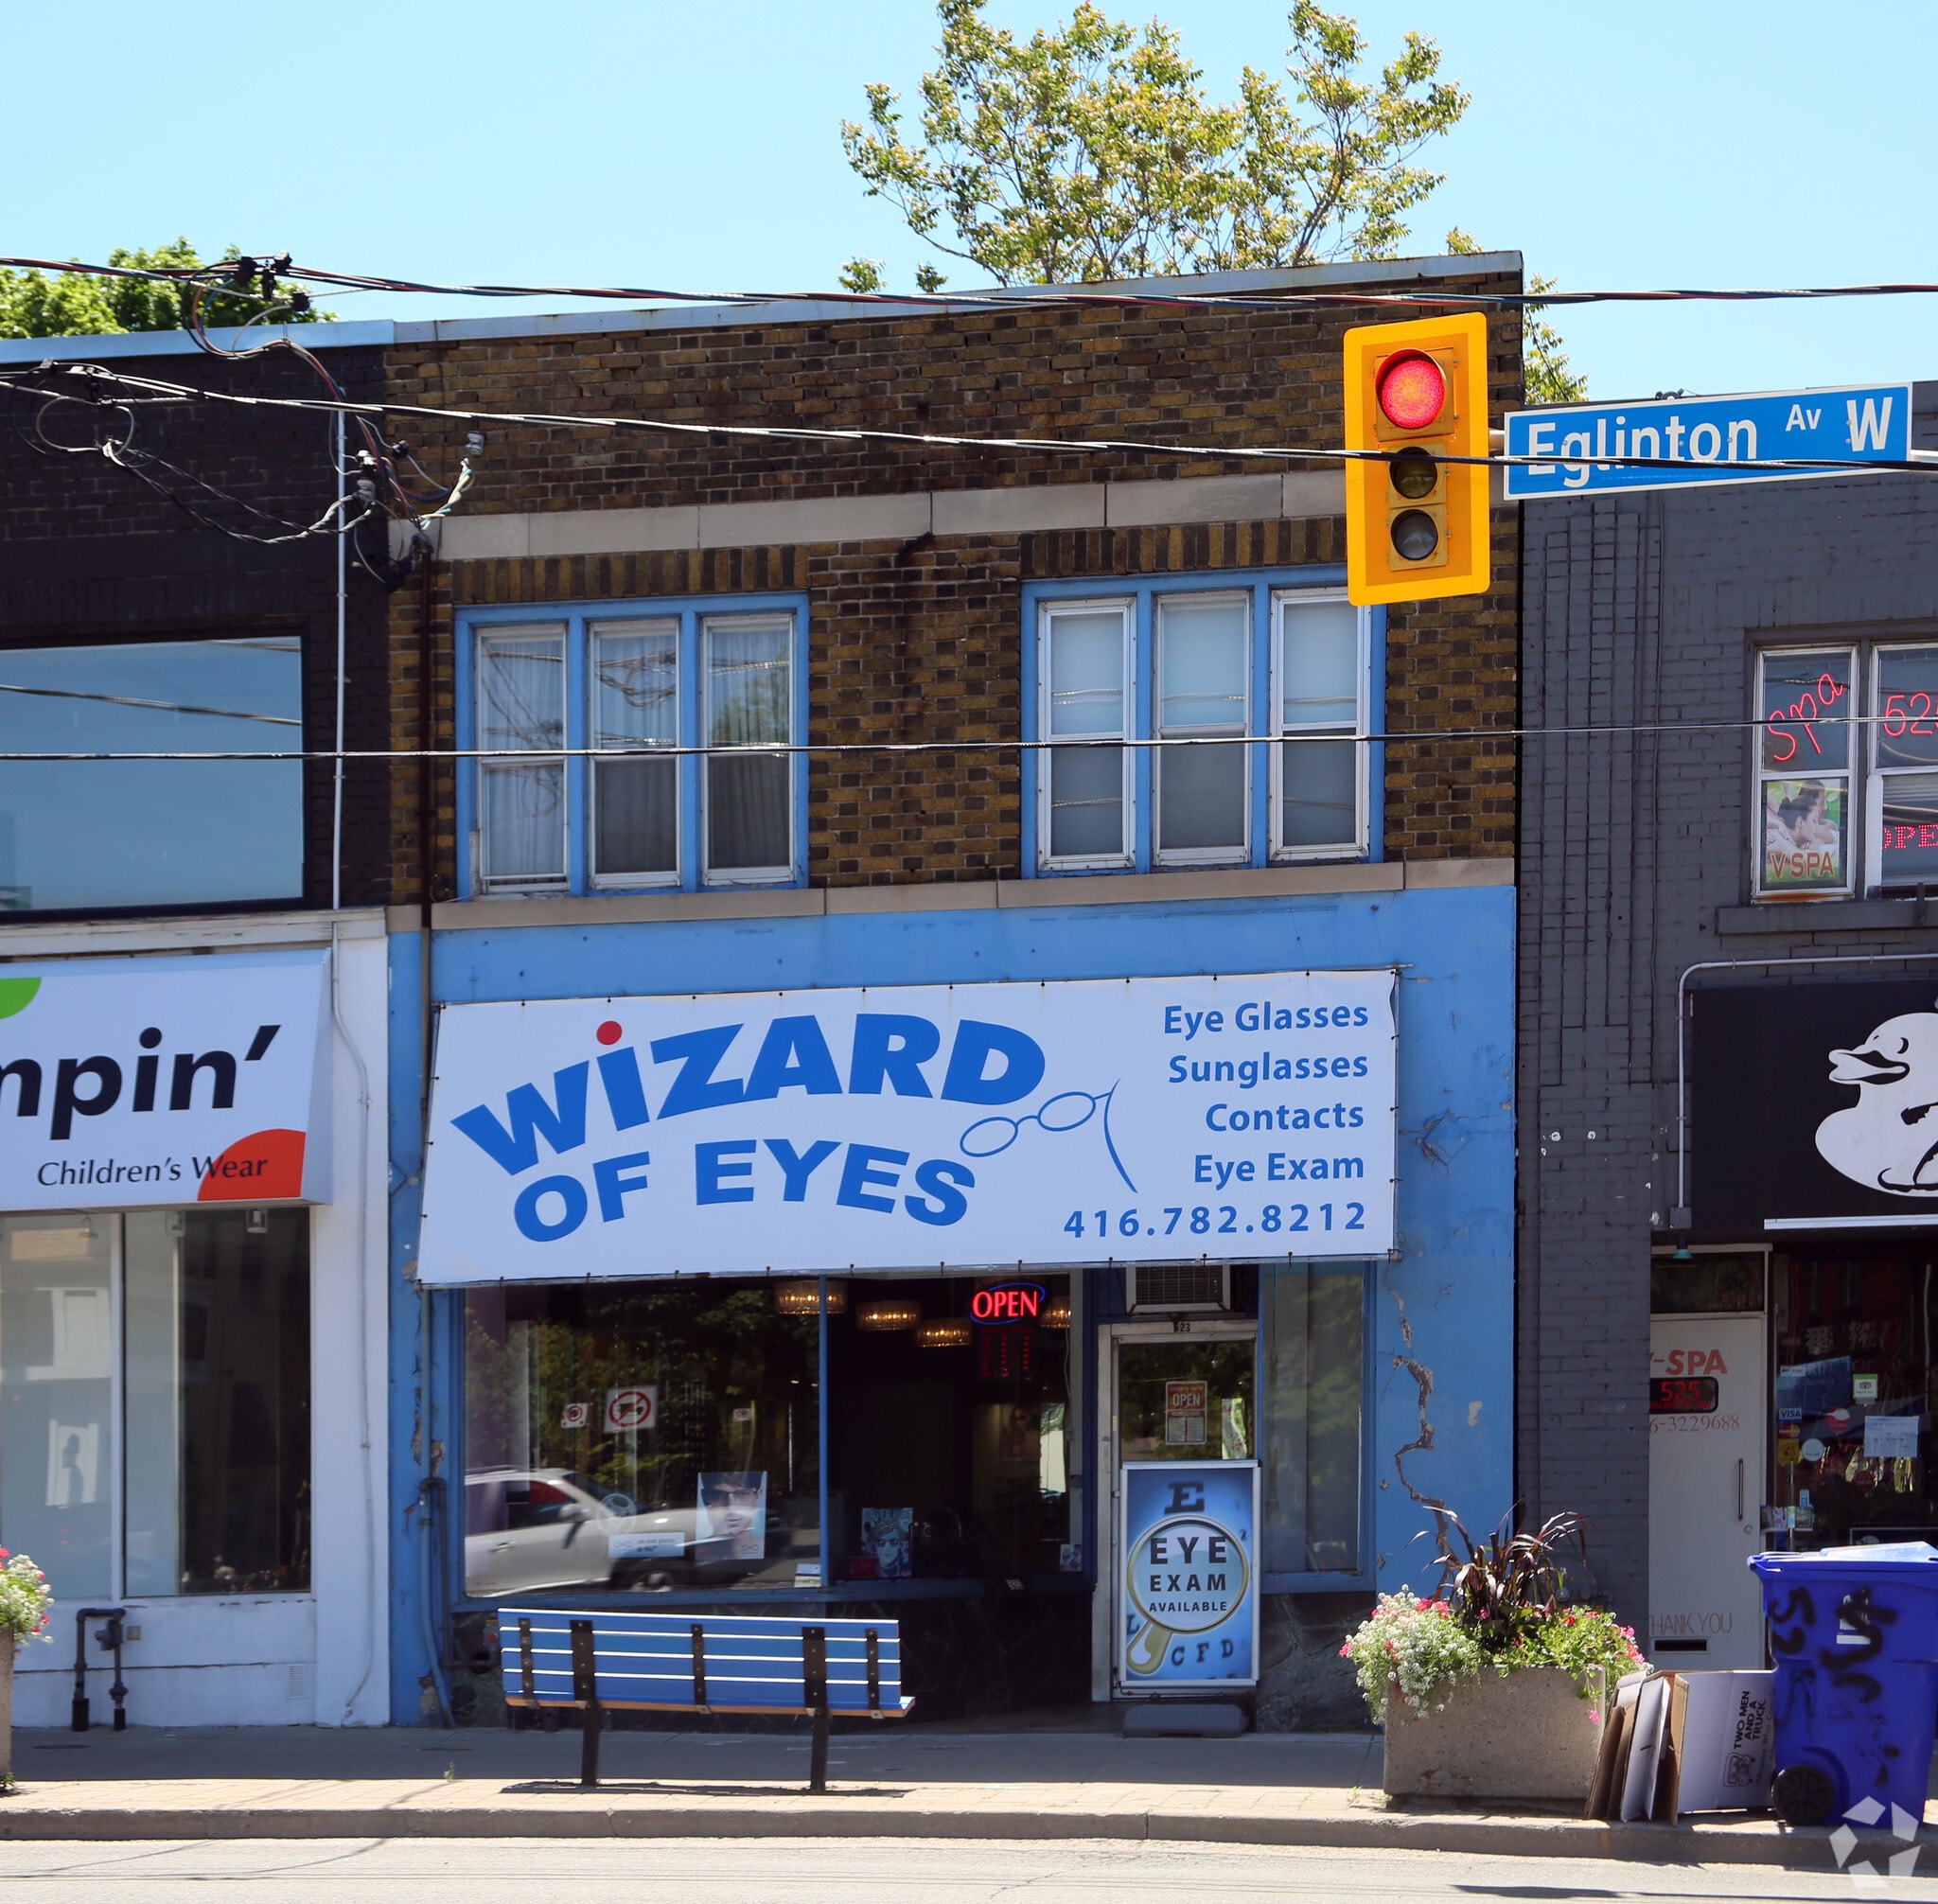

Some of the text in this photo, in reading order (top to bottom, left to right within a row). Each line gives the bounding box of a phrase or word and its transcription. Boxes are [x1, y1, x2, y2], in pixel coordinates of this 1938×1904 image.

[1527, 396, 1894, 488] Eglinton Av W
[1767, 673, 1844, 762] Spa
[1884, 692, 1938, 737] 52
[1770, 851, 1836, 880] V SPA
[1164, 1001, 1369, 1042] Eye Glasses
[1169, 1051, 1369, 1089] Sunglasses
[1205, 1102, 1365, 1133] Contacts
[37, 1155, 269, 1186] Children's Wear
[1193, 1152, 1364, 1191] Eye Exam
[513, 1138, 976, 1243] OF EYES
[1063, 1202, 1365, 1239] 416.782.8212
[972, 1290, 1038, 1318] OPEN
[1649, 1349, 1729, 1376] -SPA
[1172, 1393, 1201, 1407] OPEN
[1661, 1380, 1701, 1402] 525
[1781, 1409, 1802, 1418] VISA
[1164, 1481, 1206, 1515] E
[1150, 1536, 1227, 1565] EYE
[1150, 1573, 1226, 1593] EXAM
[1149, 1601, 1227, 1613] AVAILABLE
[1698, 1612, 1733, 1634] YOU
[1734, 1690, 1751, 1750] TWO MEN
[1744, 1700, 1758, 1740] AND A
[1752, 1699, 1767, 1741] TRUCK
